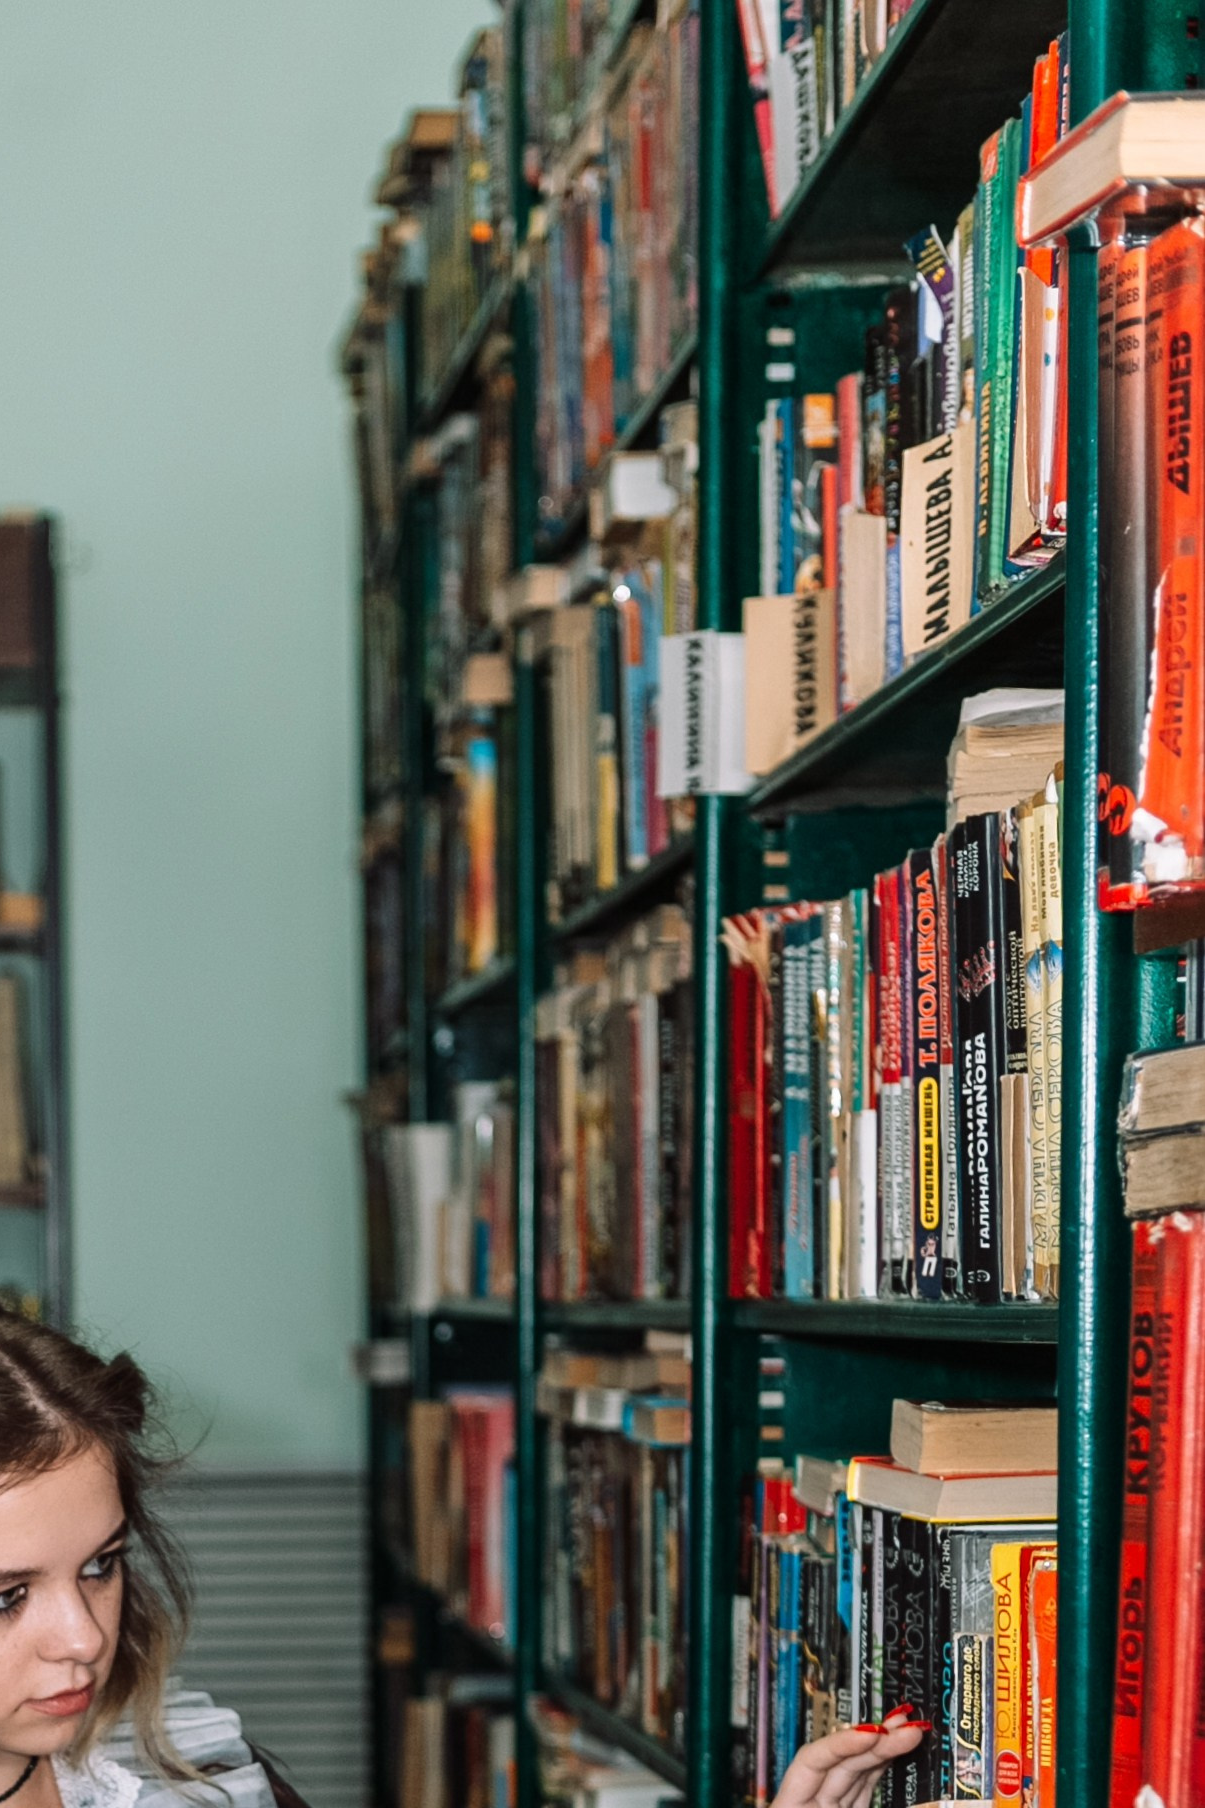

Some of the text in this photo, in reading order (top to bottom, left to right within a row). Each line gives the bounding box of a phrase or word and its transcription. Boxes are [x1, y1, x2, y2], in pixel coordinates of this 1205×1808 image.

[980, 298, 990, 369] Опасные
[978, 380, 990, 505] ЛЕВИТИНА
[1167, 331, 1192, 496] ДЫШЕВ
[921, 434, 953, 647] МАЛЫШЕВА А.
[686, 639, 703, 770] КАЛИНИНА
[794, 597, 818, 736] КУЛИКОВА
[1158, 593, 1191, 758] Андрей
[956, 849, 964, 898] ЧЕРНАЯ
[972, 840, 980, 891] КОРОНА
[1039, 825, 1047, 887] любимая
[1048, 841, 1059, 898] девочка
[915, 868, 938, 1067] Т. ПОЛЯКОВА
[939, 885, 952, 1048] Последняя любовь
[1007, 930, 1020, 1030] оптической
[1031, 918, 1039, 932] На
[893, 1094, 903, 1175] Полякова
[922, 1082, 934, 1224] СТРОПТИВАЯ МИШЕНЬ
[945, 1075, 956, 1238] Татьяна Полякова
[978, 1171, 990, 1249] ГАЛИНА
[1124, 1309, 1154, 1496] КРУТОВ
[884, 1583, 900, 1713] СТИНОВА
[906, 1590, 925, 1722] СТИНОВА
[960, 1646, 975, 1729] От первого до
[972, 1635, 982, 1742] последнего слова
[994, 1572, 1011, 1739] Ю. ШИЛОВА
[1114, 1575, 1144, 1718] Игорь
[1039, 1696, 1053, 1767] НИКОГДА
